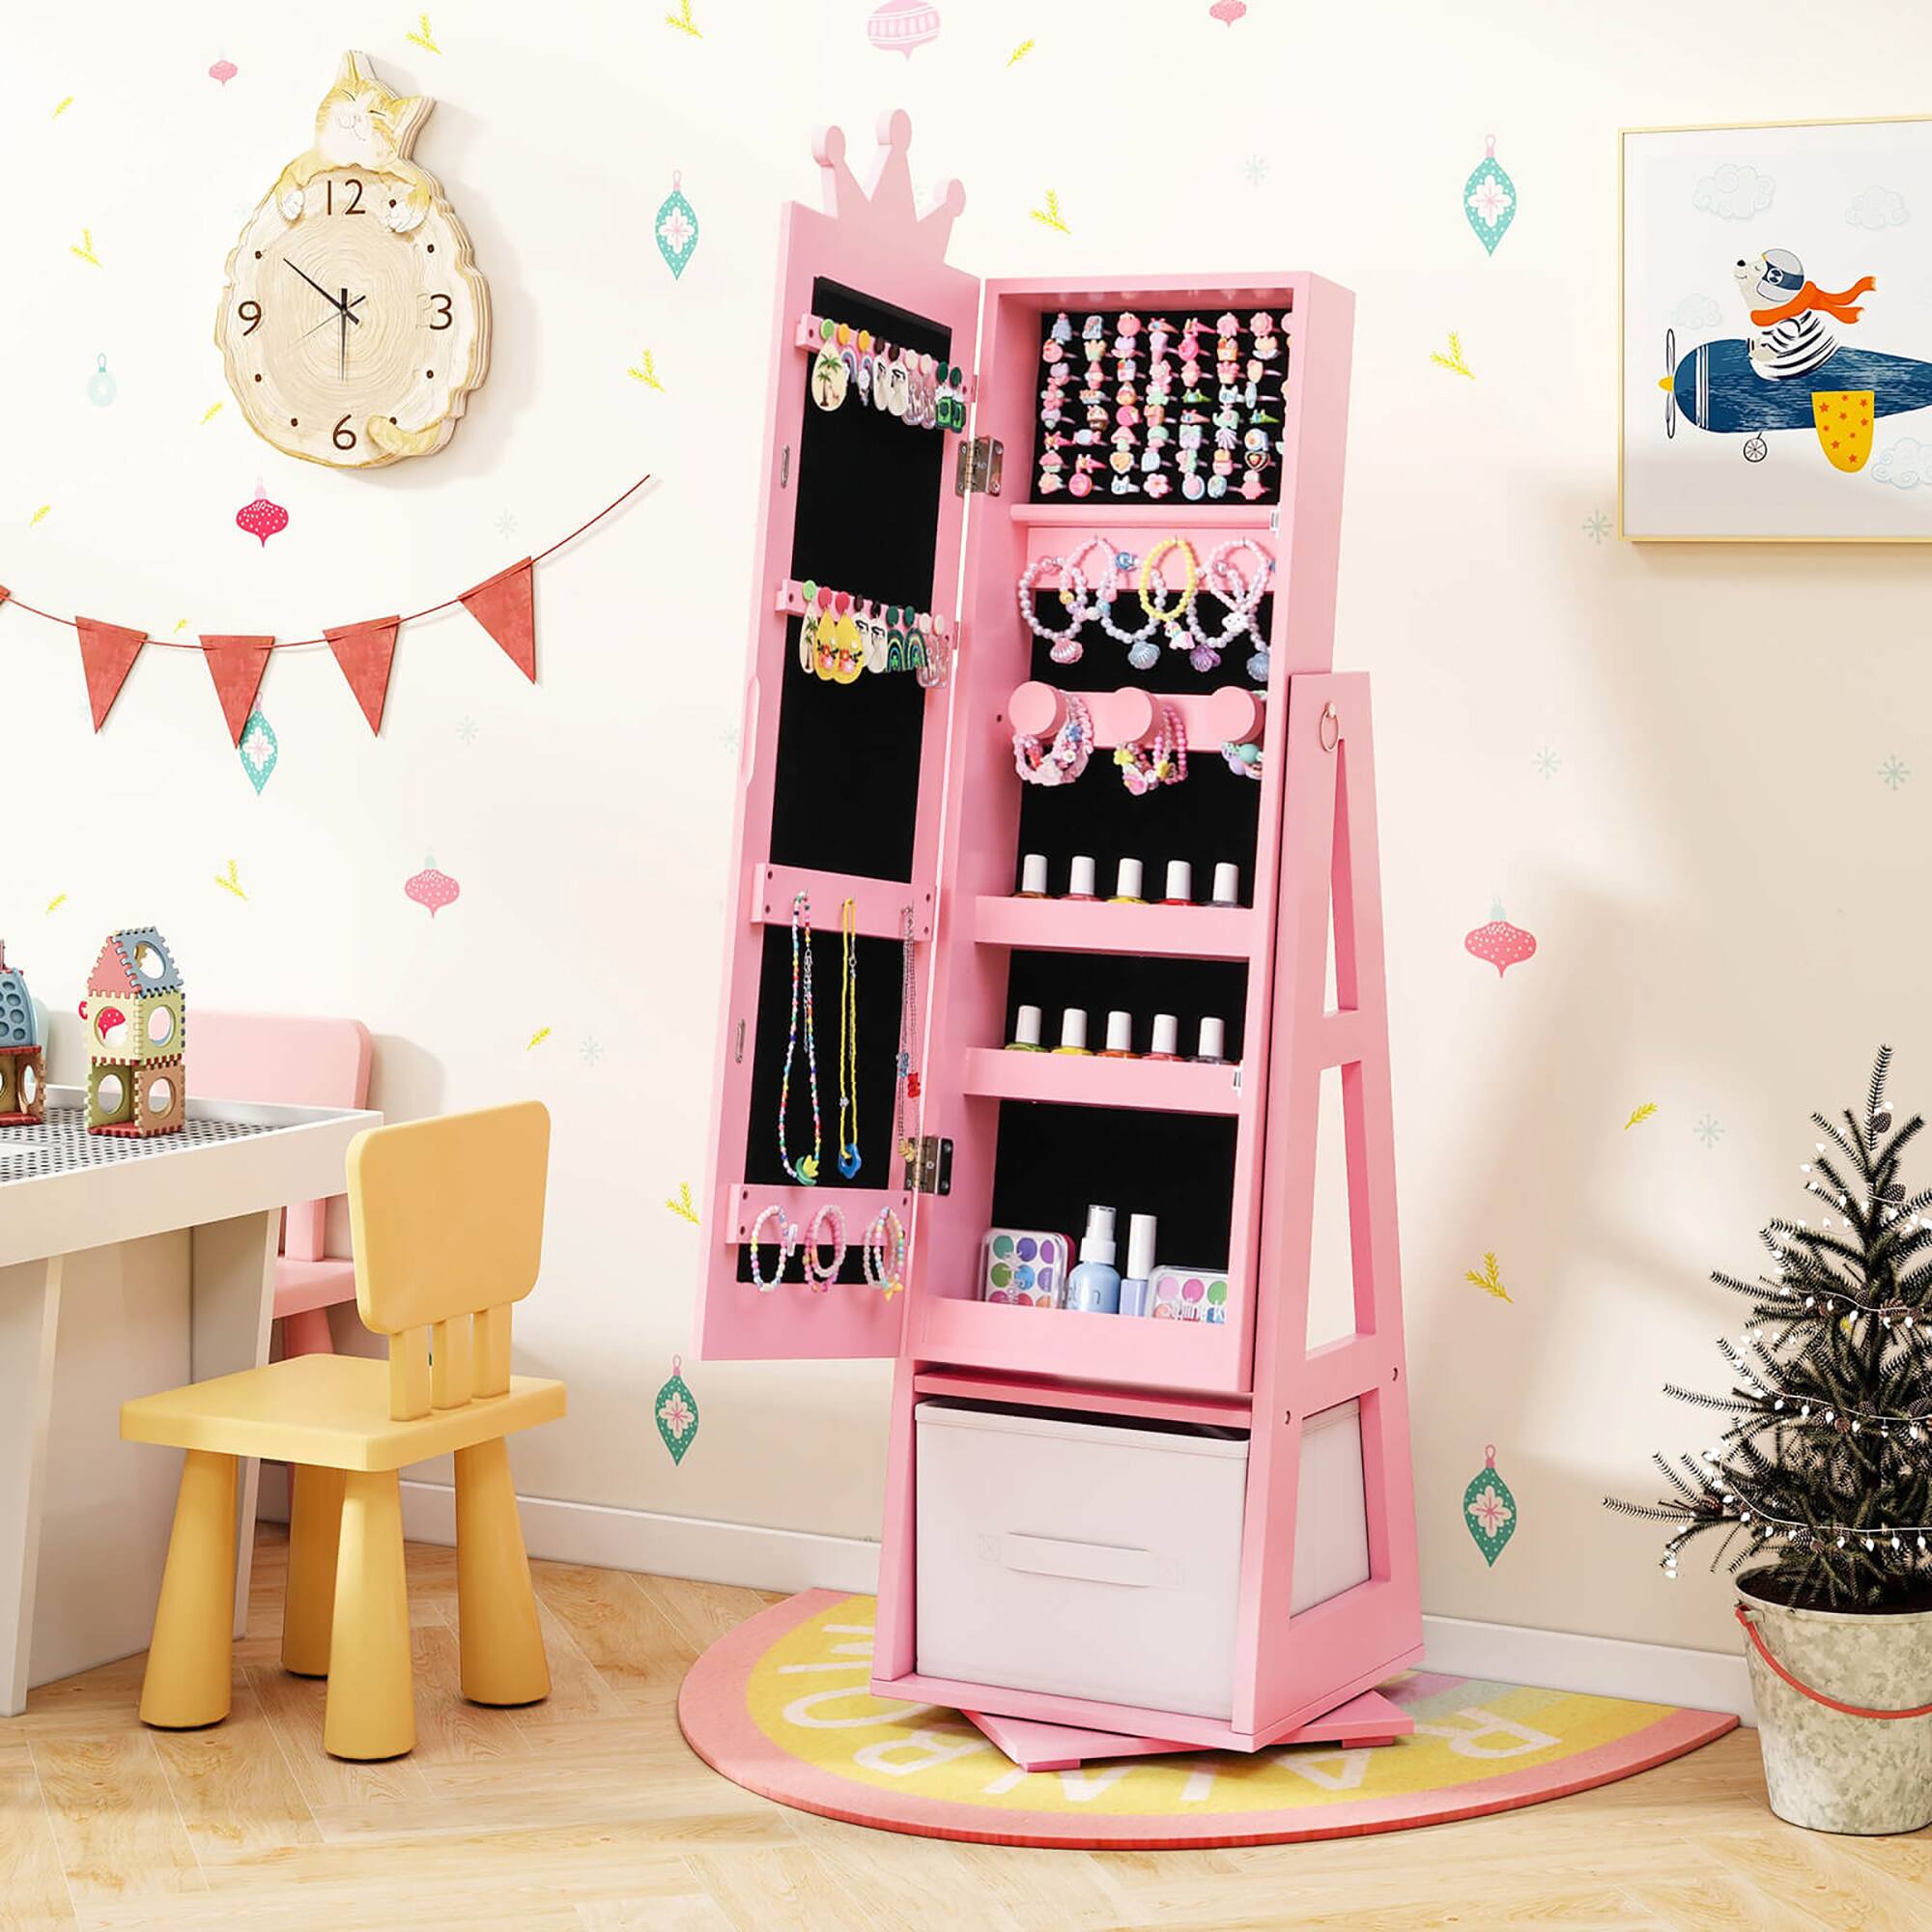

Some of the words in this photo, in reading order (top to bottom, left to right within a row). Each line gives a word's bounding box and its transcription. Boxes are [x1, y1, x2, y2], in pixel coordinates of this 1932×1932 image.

[327, 179, 365, 214] 12
[238, 300, 262, 336] 9
[429, 294, 453, 329] 3
[332, 414, 356, 450] 6
